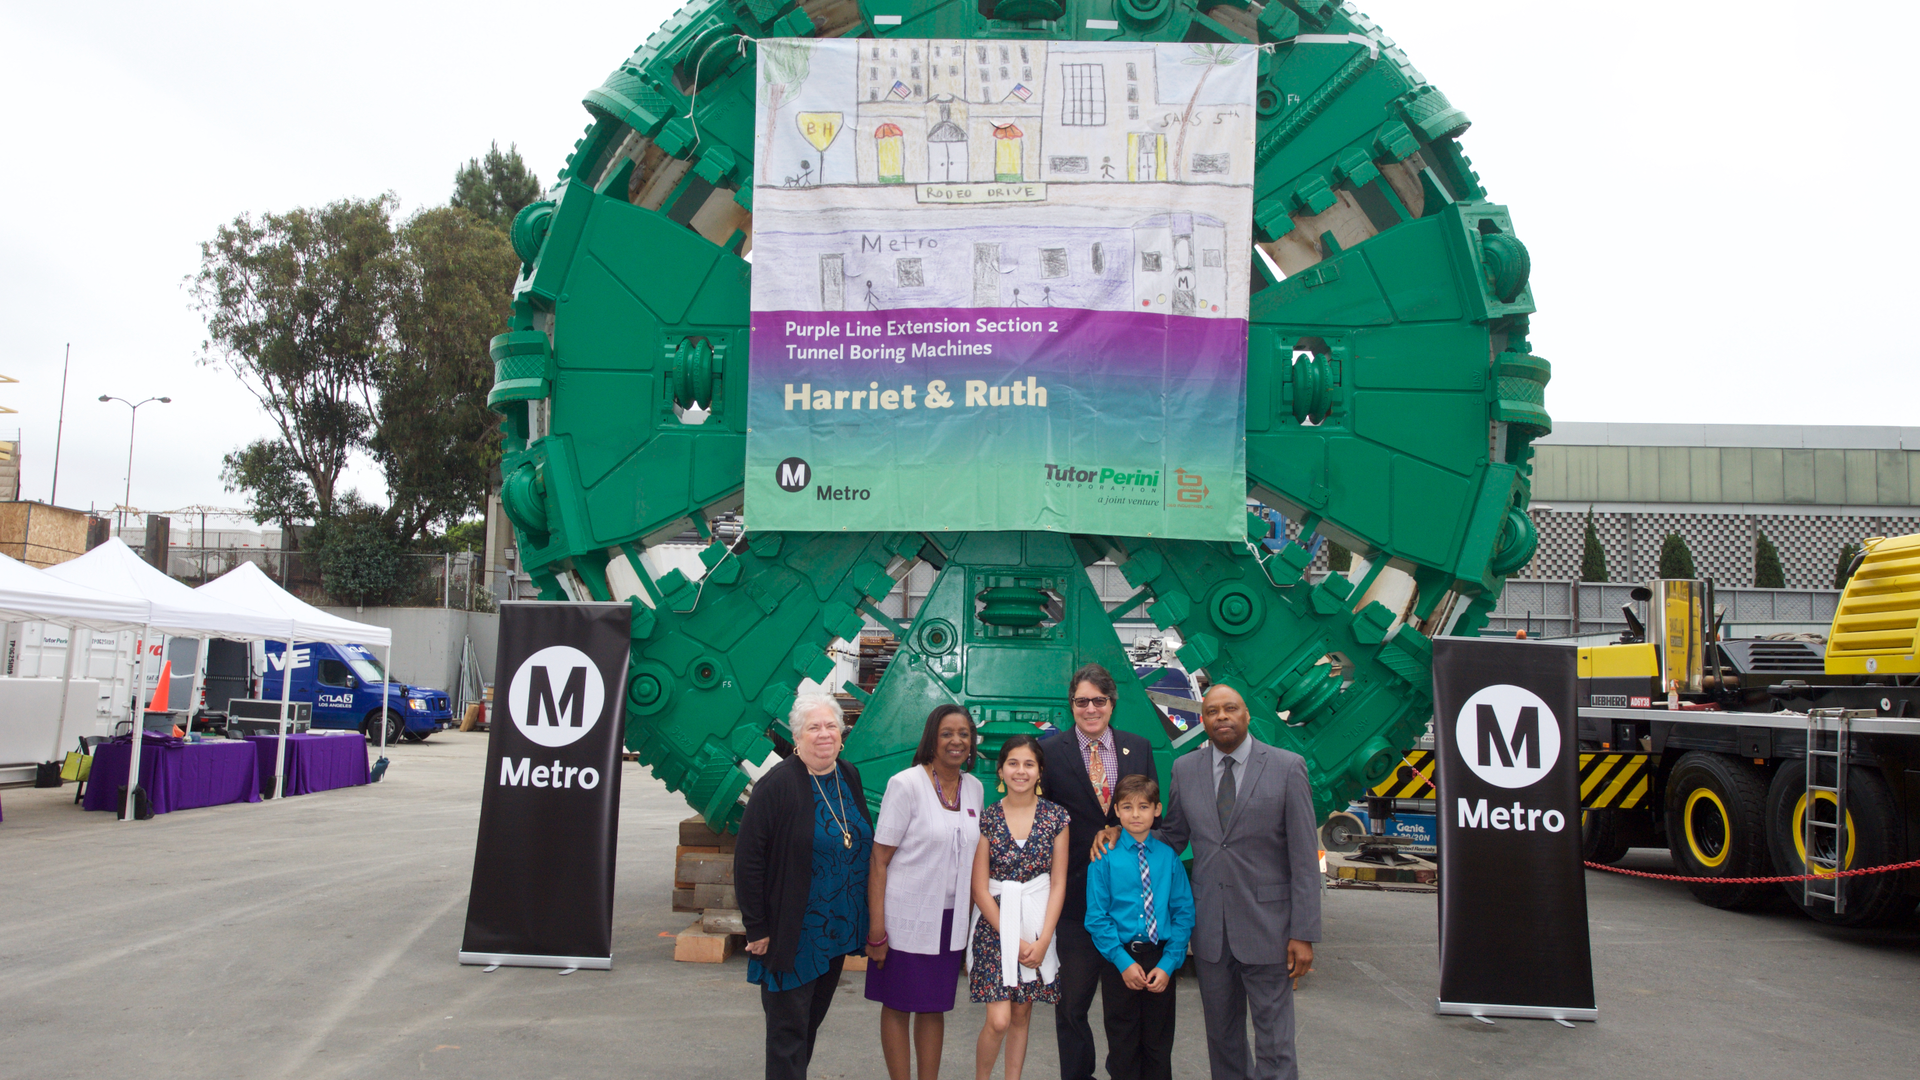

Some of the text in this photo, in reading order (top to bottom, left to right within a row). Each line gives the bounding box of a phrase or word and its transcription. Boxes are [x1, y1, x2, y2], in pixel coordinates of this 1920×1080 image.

[1287, 94, 1300, 106] F4
[926, 187, 1036, 199] RODEO DRIVE
[861, 234, 939, 254] Metro
[1178, 275, 1189, 289] M
[786, 316, 1059, 341] Purple Line Extension Section 2
[785, 339, 992, 364] Tunnel Boring Machines
[784, 376, 1048, 411] Harriet & Ruth
[781, 463, 806, 487] M
[1044, 463, 1160, 487] Tutor Perini
[816, 485, 871, 501] Metro
[1097, 495, 1160, 507] a joint venture
[318, 694, 342, 703] KTLA
[526, 665, 587, 728] M
[1592, 696, 1626, 707] LIEBHERR
[1475, 703, 1541, 770] M
[499, 757, 600, 790] Metro
[1457, 797, 1566, 833] Metro
[1396, 823, 1425, 833] Genie
